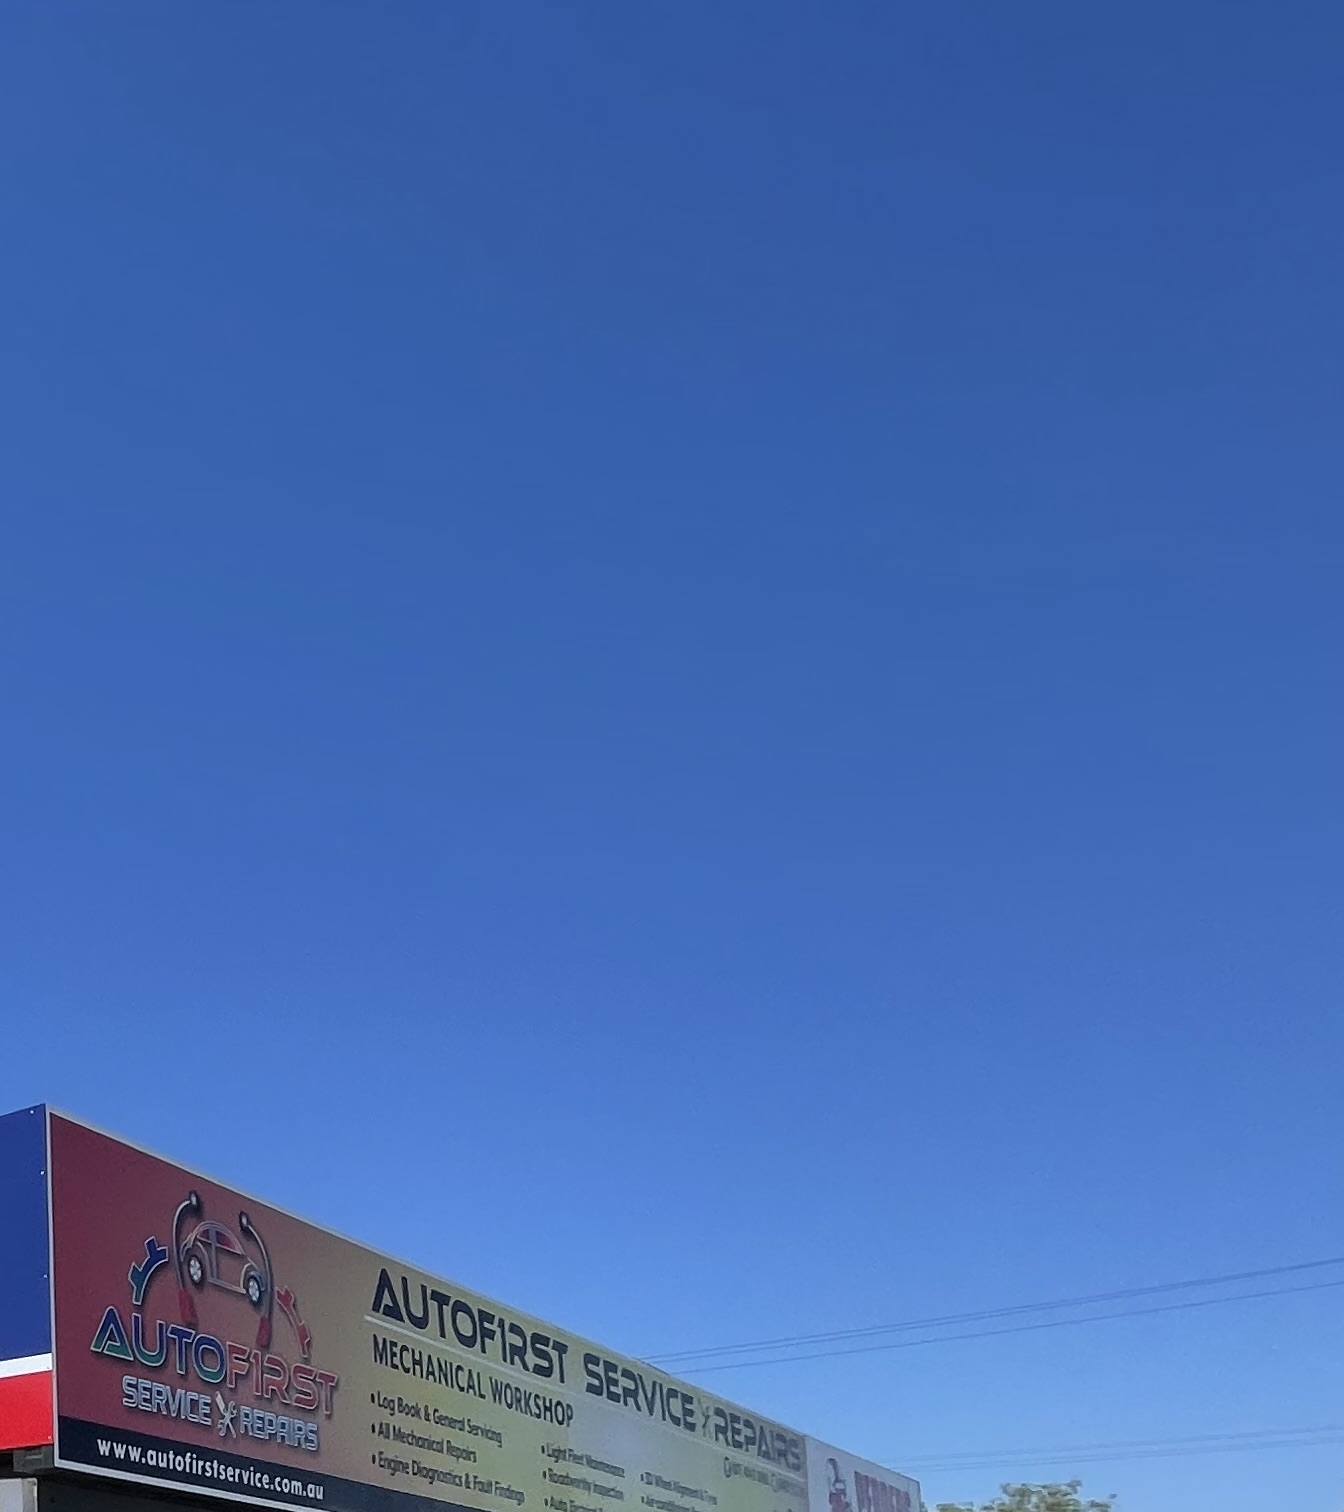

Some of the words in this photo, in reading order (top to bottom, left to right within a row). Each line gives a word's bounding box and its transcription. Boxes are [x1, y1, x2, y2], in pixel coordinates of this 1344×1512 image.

[372, 1333, 486, 1400] MECHANICAL
[489, 1376, 574, 1428] WORKSHOP
[377, 1390, 396, 1416] Log
[398, 1397, 422, 1419] Book
[424, 1405, 431, 1423] &
[433, 1408, 465, 1431] General
[122, 1374, 212, 1426] SERVICE
[240, 1405, 319, 1451] REPAIRS
[378, 1422, 390, 1440] All
[392, 1424, 444, 1454] Mechanical
[446, 1440, 478, 1464] Repairs
[583, 1352, 697, 1432] SERVICE
[714, 1406, 802, 1473] REPAIRS
[97, 1438, 324, 1501] www.autofirstservice.com.au
[378, 1451, 410, 1476] Engine
[412, 1460, 464, 1487] Diagnostics
